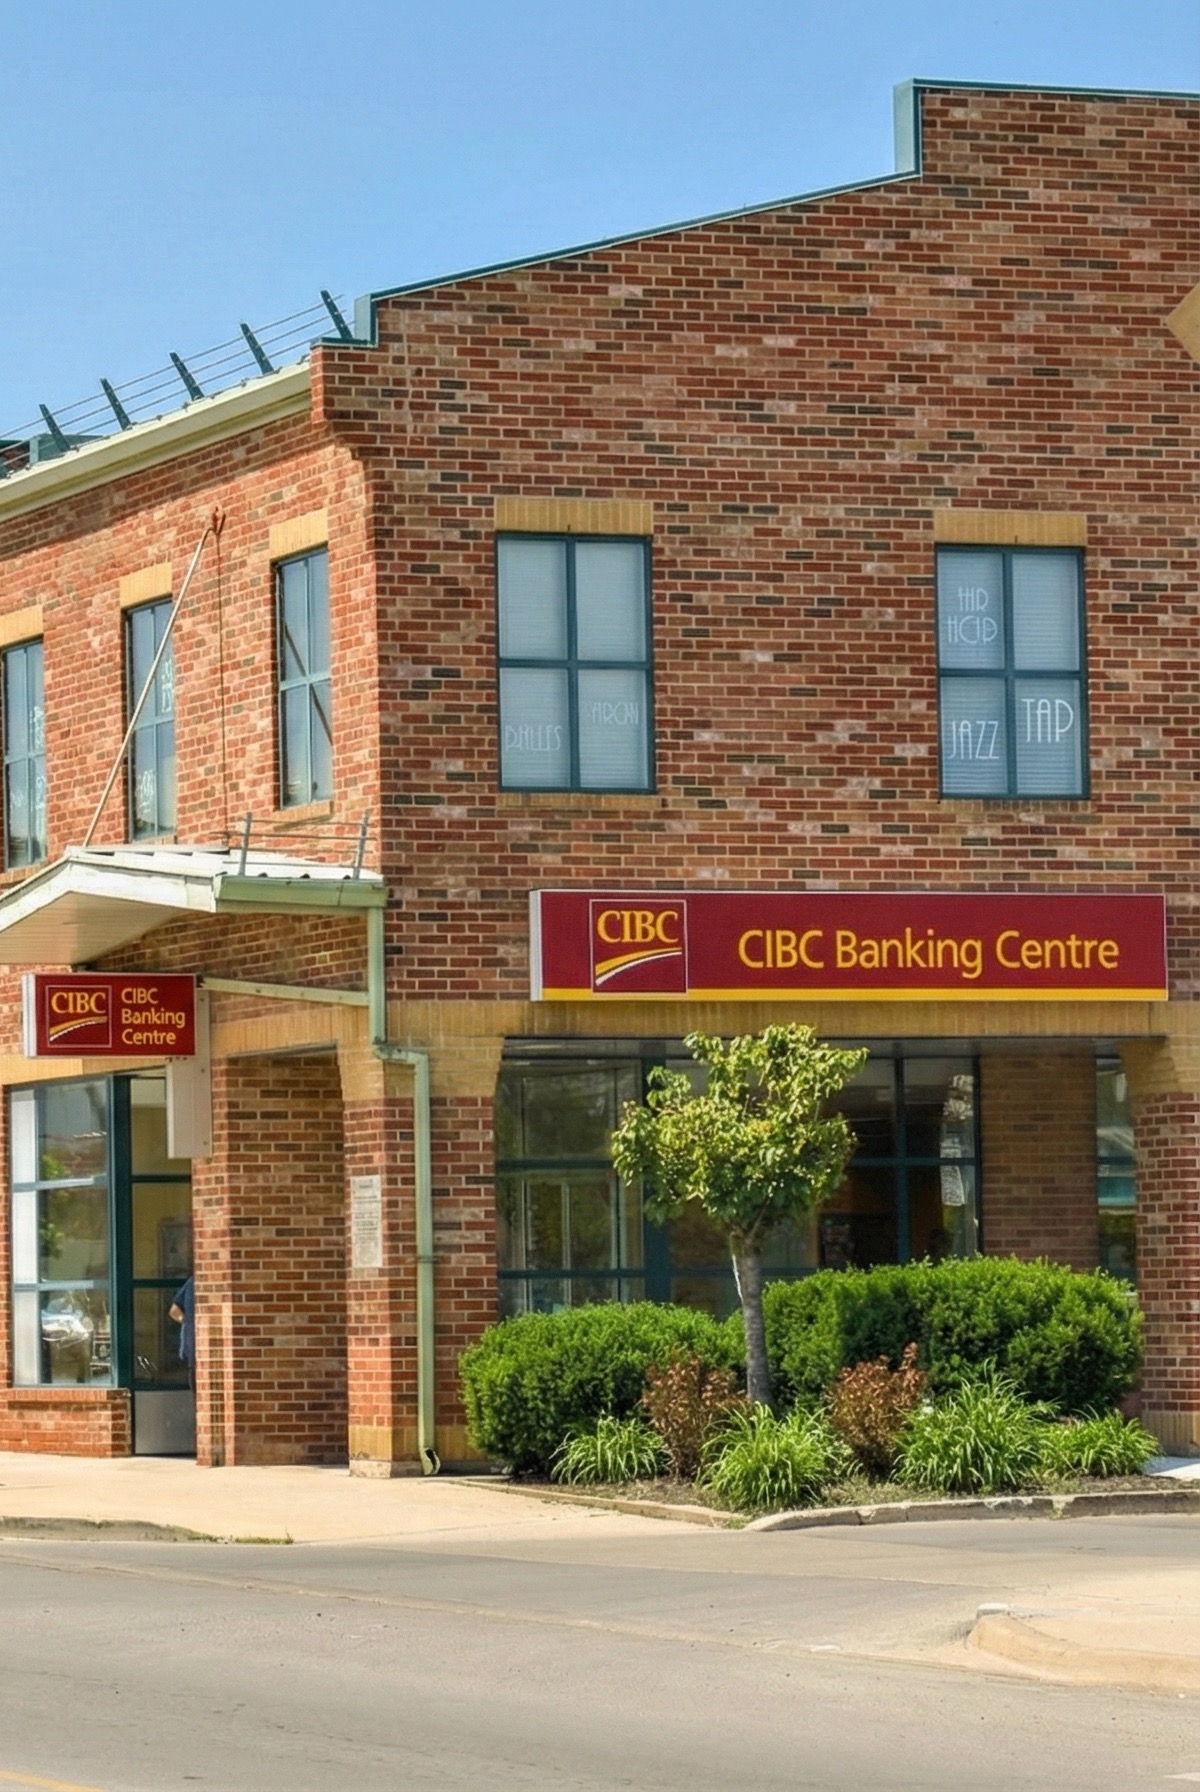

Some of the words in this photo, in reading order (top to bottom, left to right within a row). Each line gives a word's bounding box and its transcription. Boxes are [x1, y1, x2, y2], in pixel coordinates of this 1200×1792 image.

[1021, 698, 1074, 743] TAP
[948, 720, 1000, 760] JAZZ
[597, 910, 679, 943] CIBC
[738, 930, 824, 968] CIBC
[836, 927, 983, 979] Banking
[996, 930, 1119, 969] Centre
[51, 992, 107, 1014] CIBC
[121, 988, 159, 1004] CIBC
[121, 1008, 185, 1029] Banking
[122, 1029, 176, 1045] Centre
